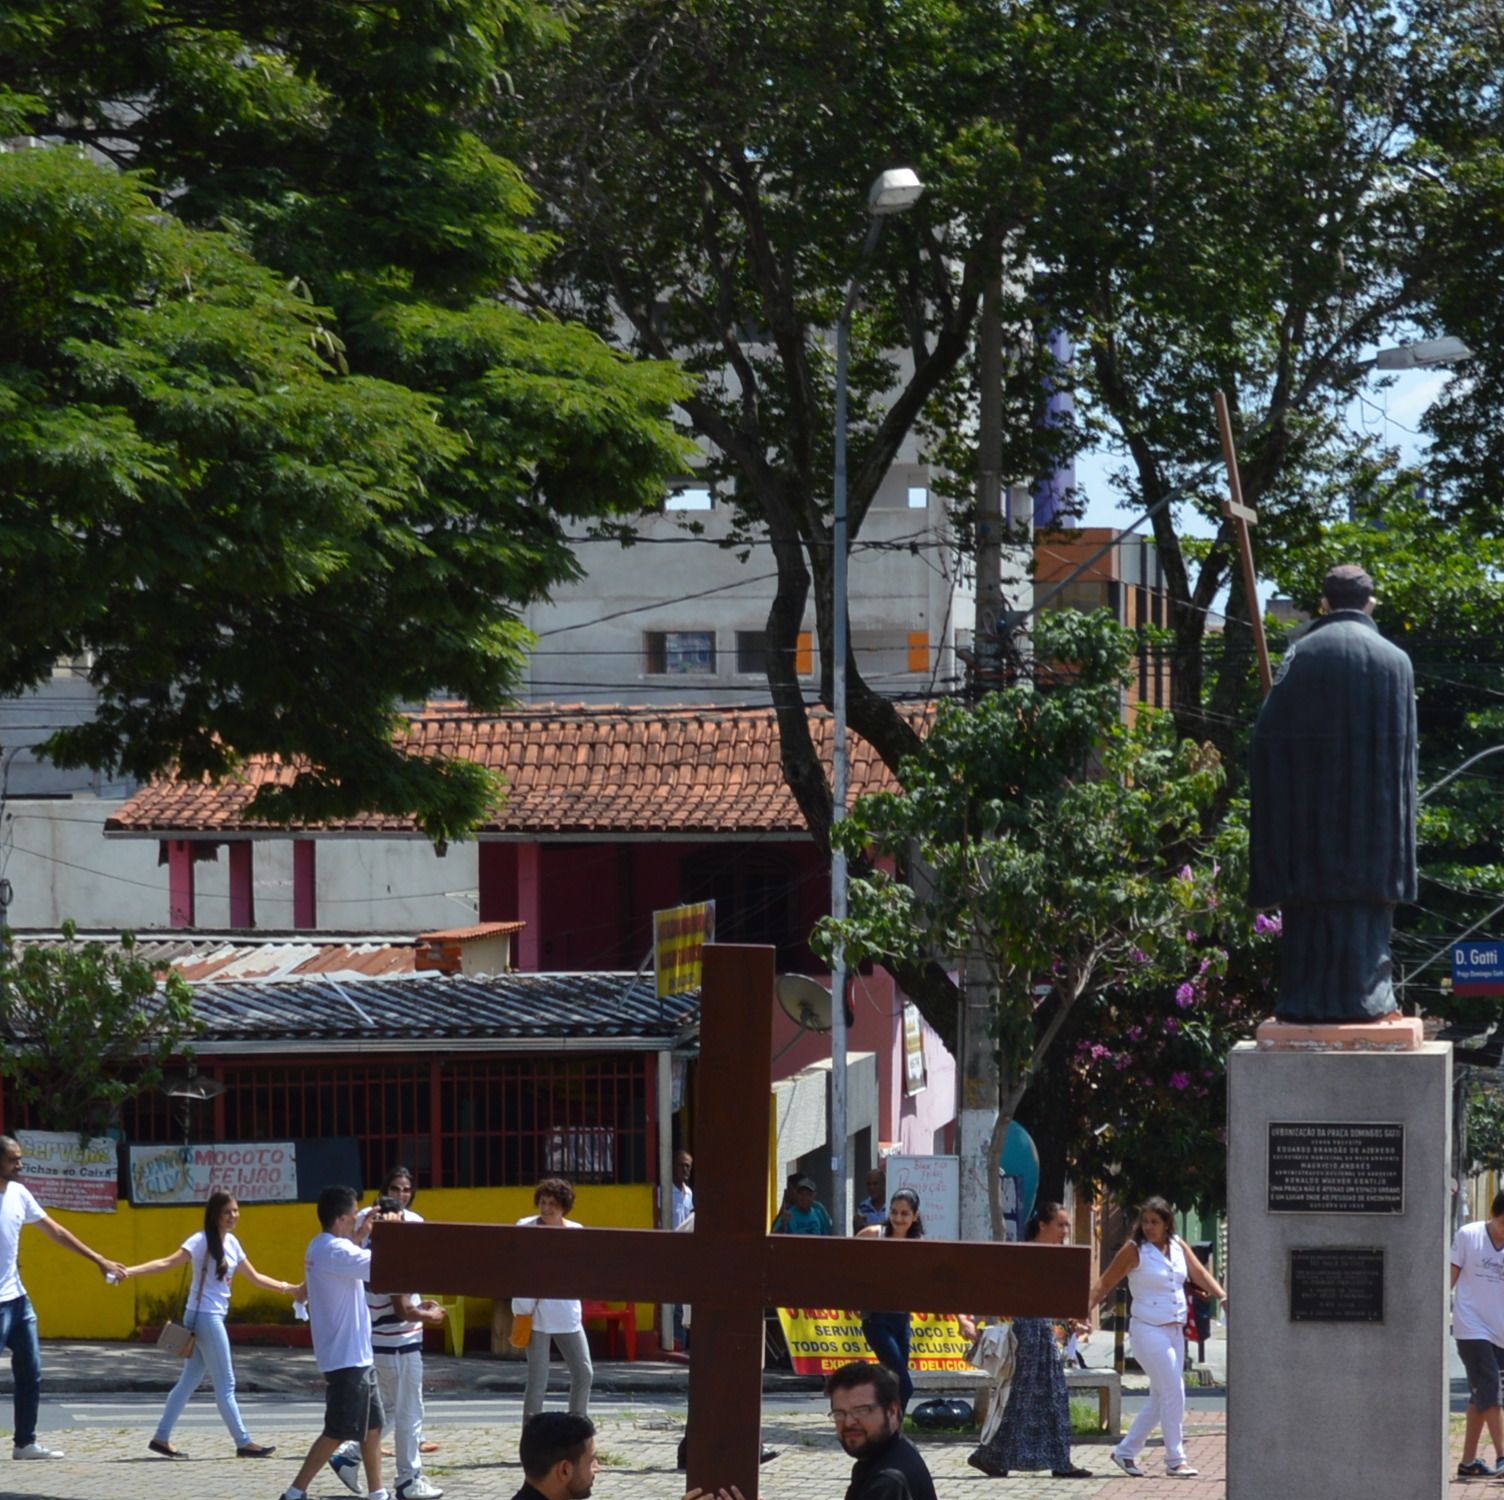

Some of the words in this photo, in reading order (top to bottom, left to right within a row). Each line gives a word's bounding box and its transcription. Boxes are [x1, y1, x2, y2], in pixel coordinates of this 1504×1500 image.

[1470, 949, 1498, 965] Gatti
[814, 1325, 864, 1337] SERVIM
[947, 1328, 956, 1337] E
[792, 1341, 838, 1352] TODOS
[842, 1341, 861, 1352] OS
[909, 1342, 971, 1353] NCLUSIVE
